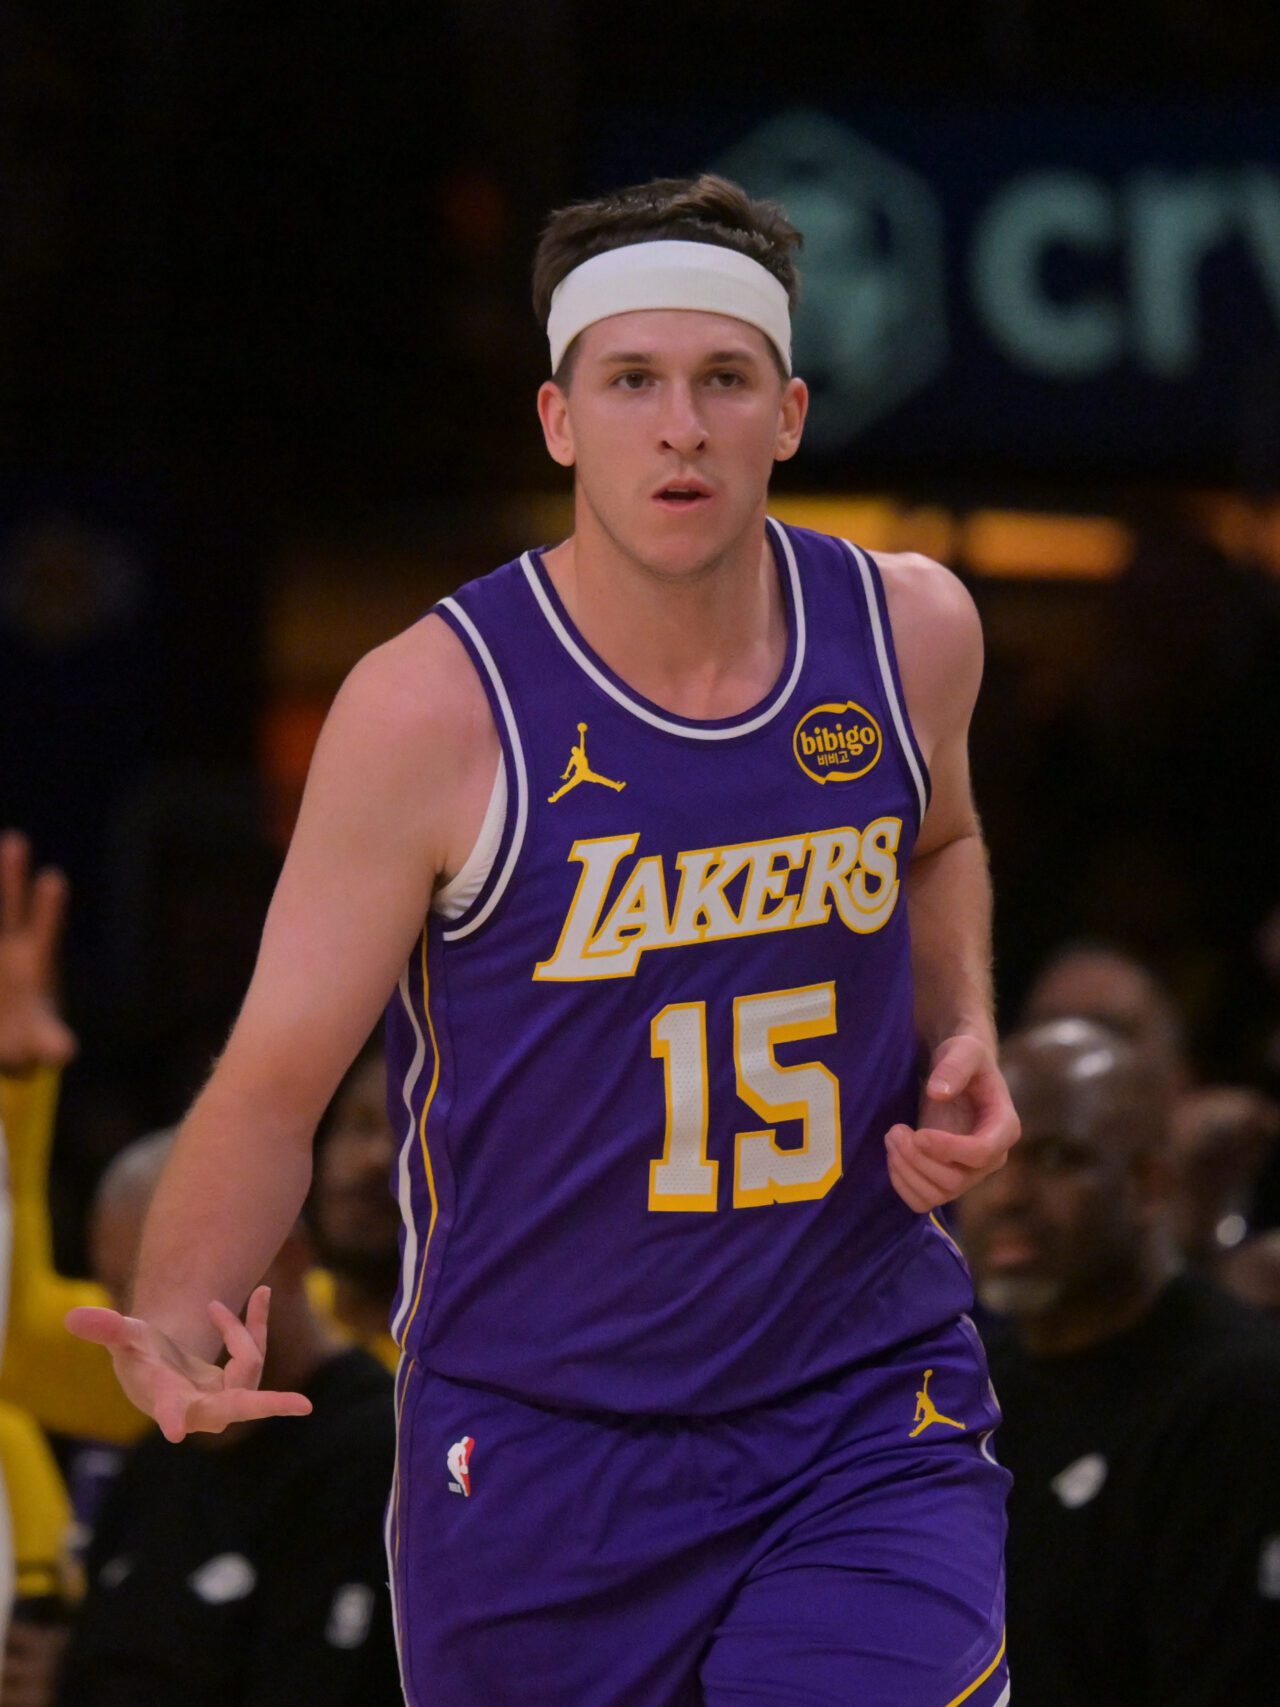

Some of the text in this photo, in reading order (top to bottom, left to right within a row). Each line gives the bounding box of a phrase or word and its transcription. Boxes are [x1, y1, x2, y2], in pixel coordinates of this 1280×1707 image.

[800, 723, 876, 756] bibigo
[817, 751, 850, 766] 비비고
[532, 816, 903, 982] LAKERS
[648, 980, 843, 1213] 15
